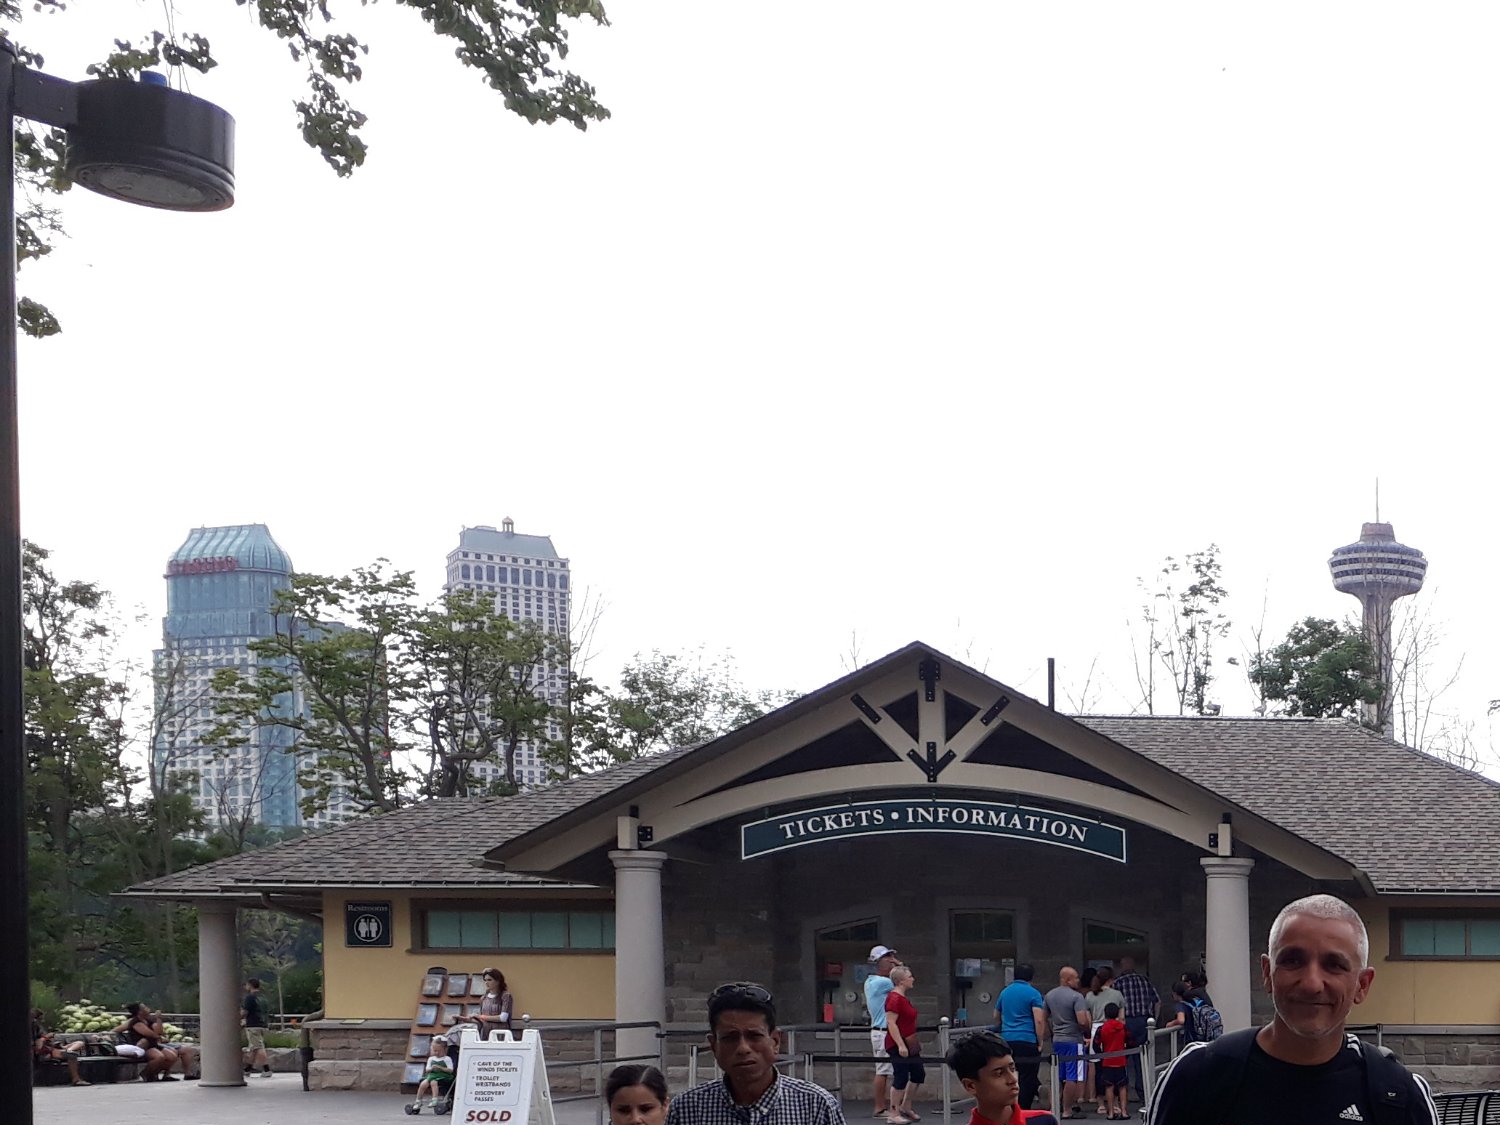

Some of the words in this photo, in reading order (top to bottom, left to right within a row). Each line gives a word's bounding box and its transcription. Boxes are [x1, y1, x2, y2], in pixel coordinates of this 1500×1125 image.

[778, 808, 886, 840] TICKETS
[905, 806, 1090, 843] INFORMATION
[465, 1110, 512, 1123] SOLD
[1338, 1112, 1364, 1122] adidas
